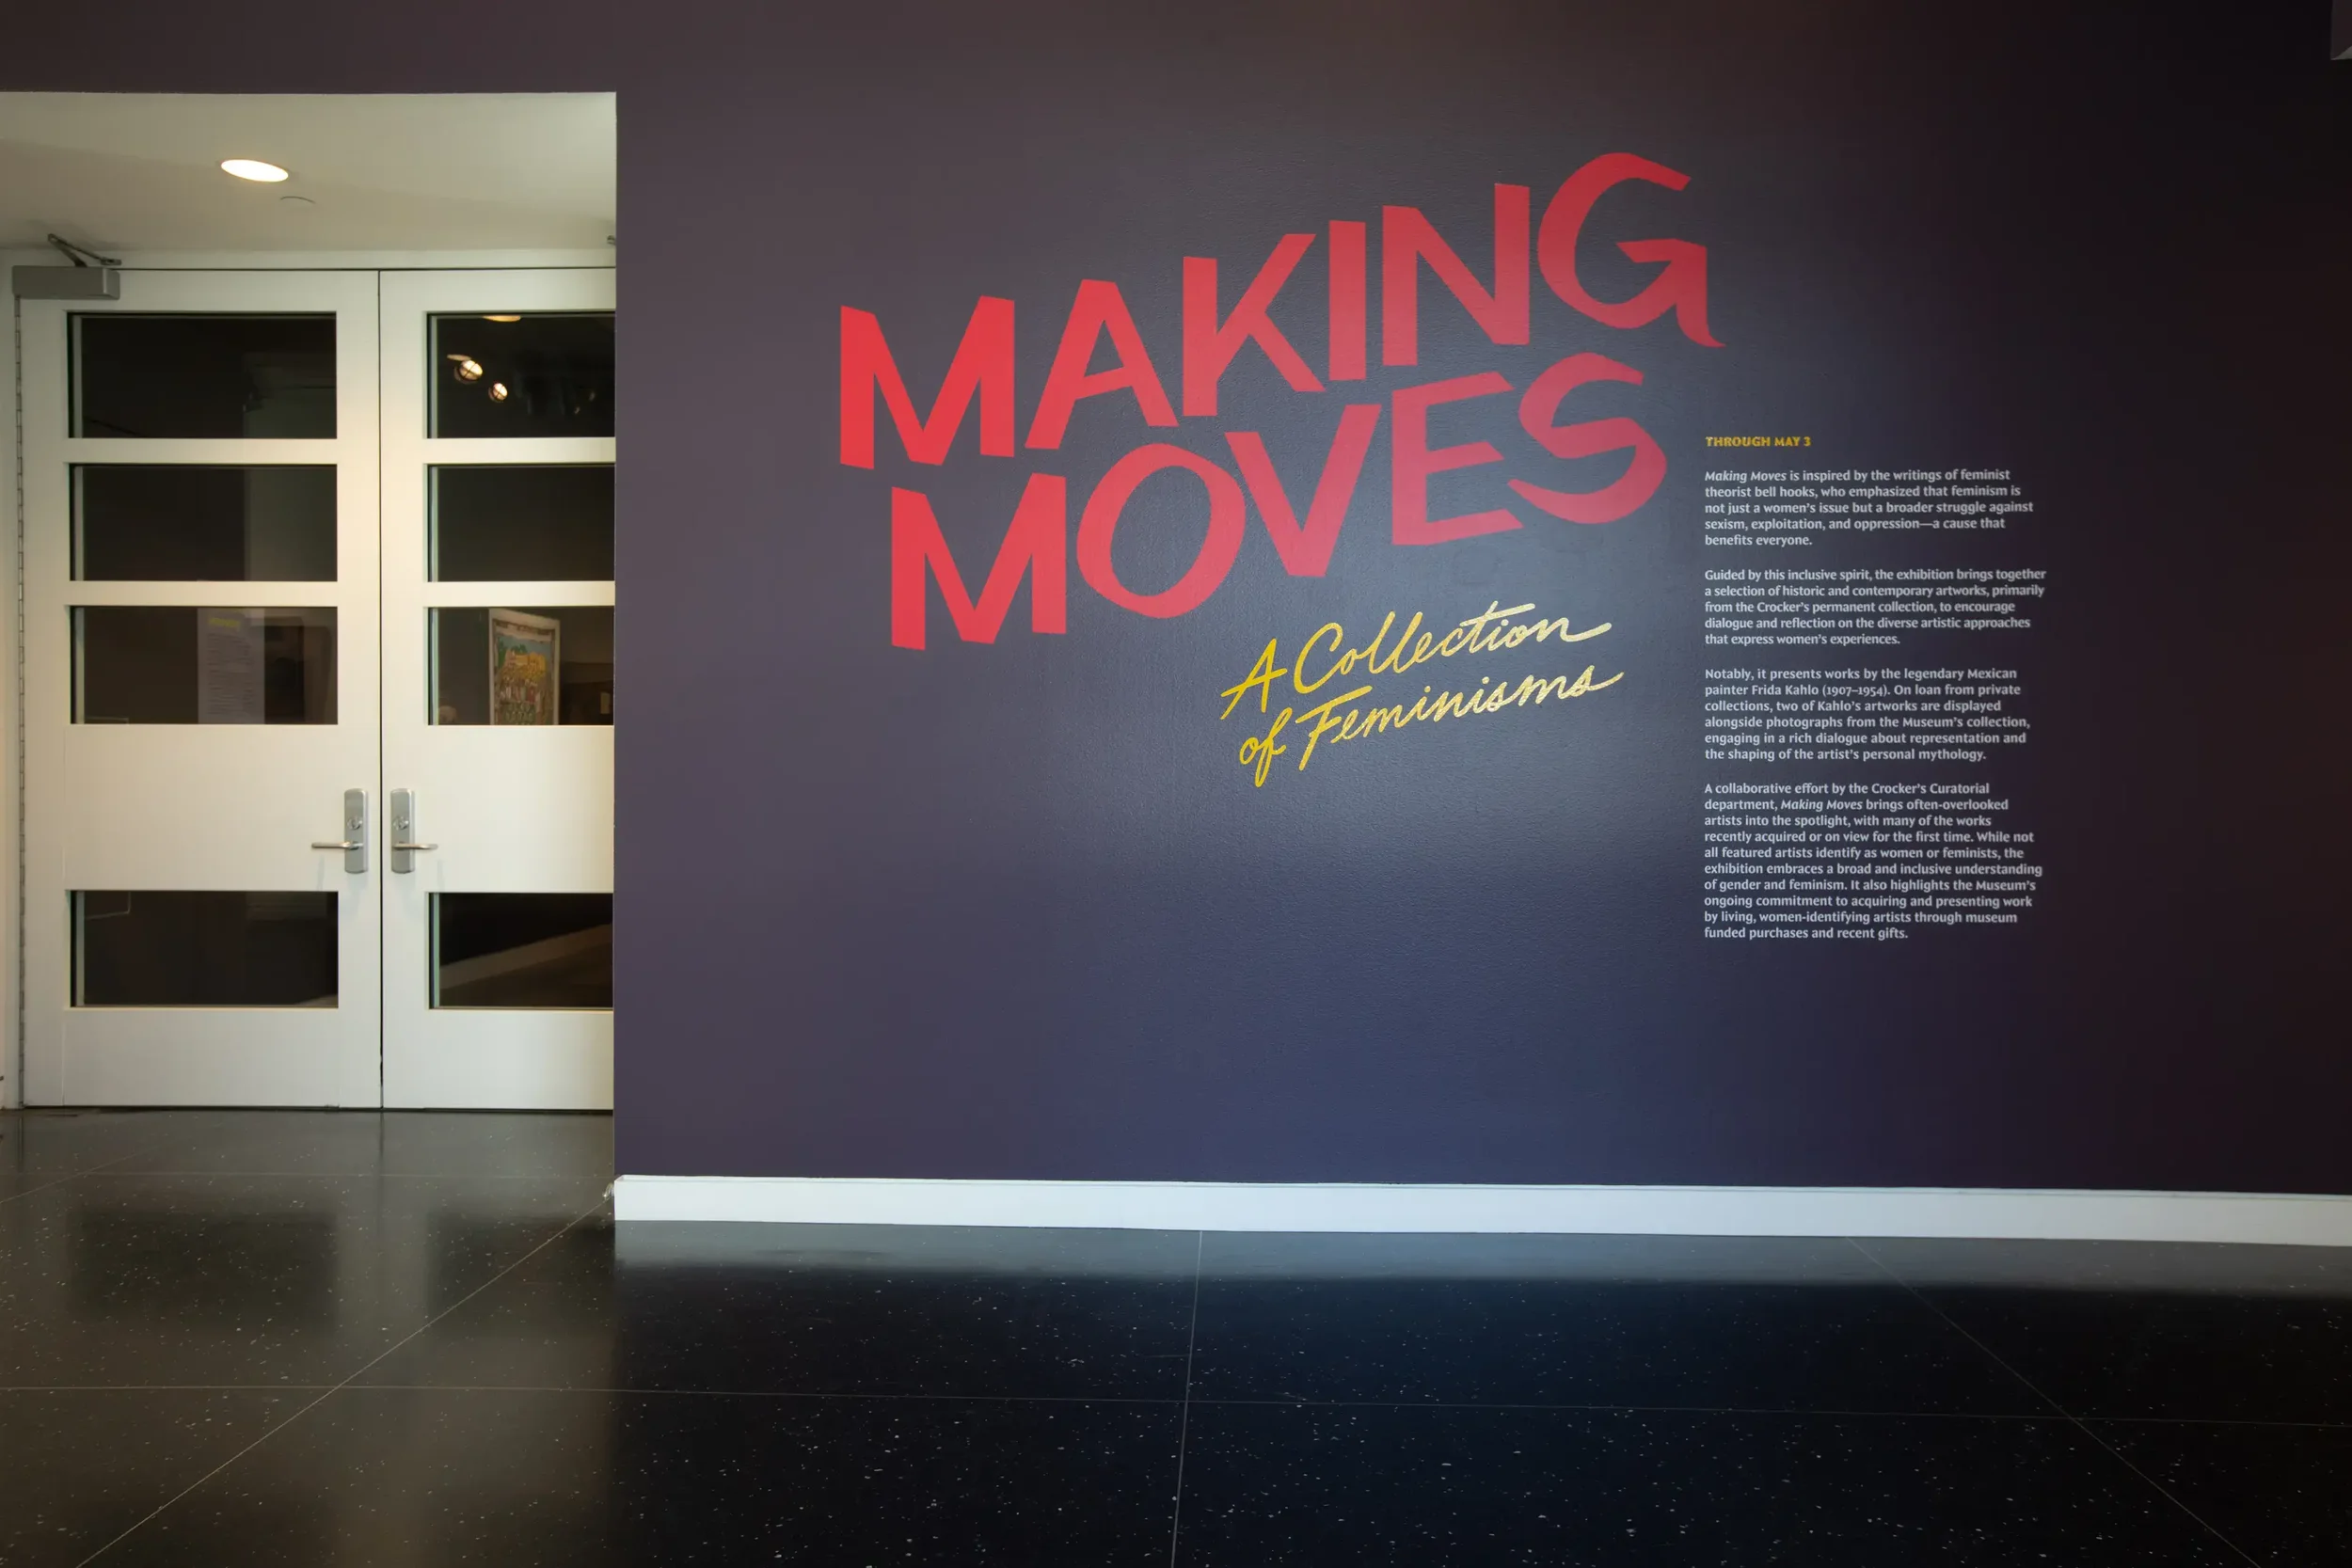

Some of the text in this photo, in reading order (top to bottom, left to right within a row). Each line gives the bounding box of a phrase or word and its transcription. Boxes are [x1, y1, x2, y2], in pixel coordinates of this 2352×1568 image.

[840, 153, 1723, 469] MAKING
[1706, 436, 1811, 446] THROUGH MAY 3
[1705, 468, 2010, 483] Making Moves is inspired by the writings of feminist
[1705, 485, 2021, 499] theorist bell hooks, who emphasized that feminism is
[891, 353, 1666, 651] MOVES
[1705, 517, 2006, 531] sexism, exploitation, and oppression—a cause that
[1705, 534, 1813, 547] benefits everyone.
[1705, 568, 2047, 582] Guided by this inclusive spirit, the exhibition brings together
[1705, 601, 2016, 614] from the Crocker’s permanent collection, to encourage
[1705, 617, 2031, 630] dialogue and reflection on the diverse artistic approaches
[1220, 600, 1613, 720] A Collection
[1705, 668, 2017, 681] Notably, it presents works by the legendary Mexican
[1705, 684, 2021, 697] painter Frida Kahlo (1907–1954). On loan from private
[1705, 700, 2001, 713] collections, two of Kahlo’s artworks are displayed
[1239, 665, 1625, 787] of Feminisms
[1705, 716, 2030, 730] alongside photographs from the Museum’s collection,
[1705, 749, 1987, 762] the shaping of the artist’s personal mythology.
[1704, 783, 1990, 796] A collaborative effort by the Crocker’s Curatorial
[1704, 799, 2009, 812] department, Making Moves brings often-overlooked
[1704, 815, 1992, 828] artists into the spotlight, with many of the works
[1704, 847, 2025, 860] all featured artists identify as women or feminists, the
[1704, 863, 2042, 877] exhibition embraces a broad and inclusive understanding
[1704, 895, 2032, 909] ongoing commitment to acquiring and presenting work
[1704, 911, 2018, 925] by living, women-identifying artists through museum
[1704, 927, 1908, 941] funded purchases and recent gifts.
